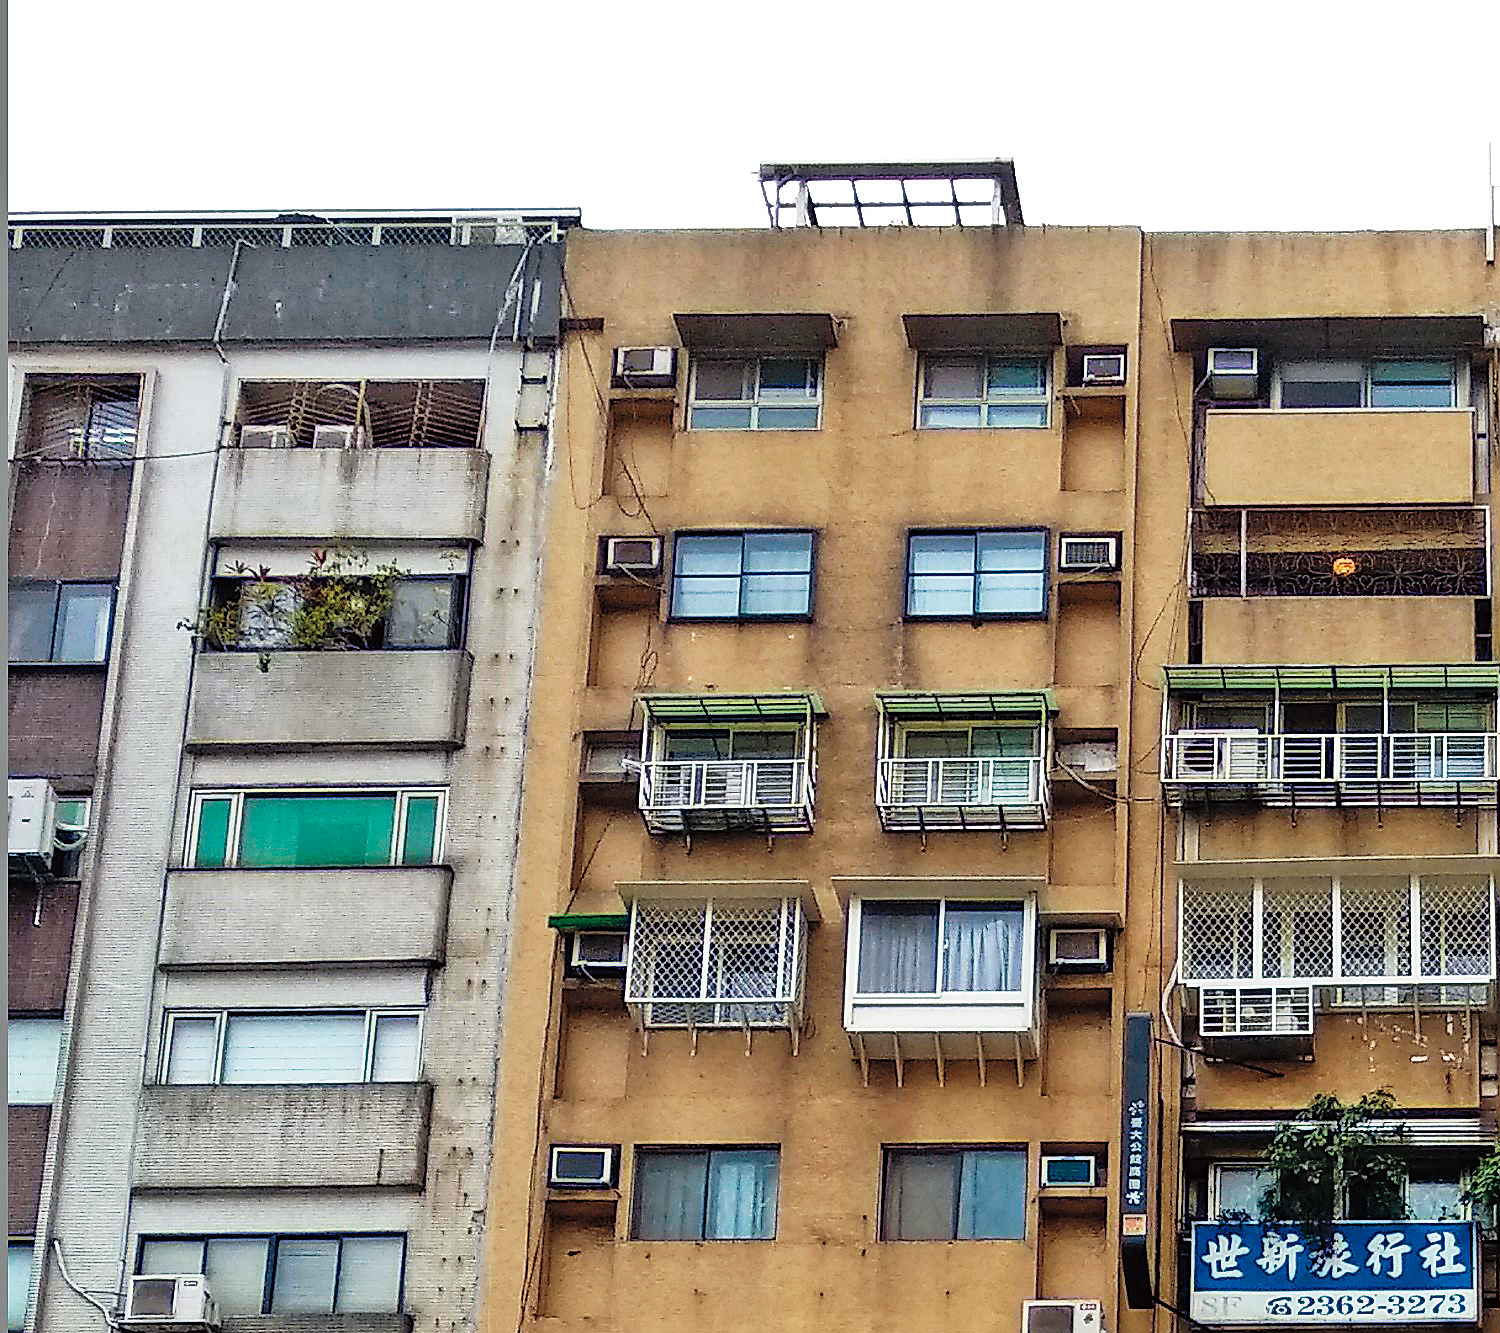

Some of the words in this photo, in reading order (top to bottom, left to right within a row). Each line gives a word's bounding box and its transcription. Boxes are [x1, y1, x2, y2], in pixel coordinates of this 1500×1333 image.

[1201, 1231, 1468, 1281] 世新旅行社
[1297, 1293, 1467, 1316] 2362-3273
